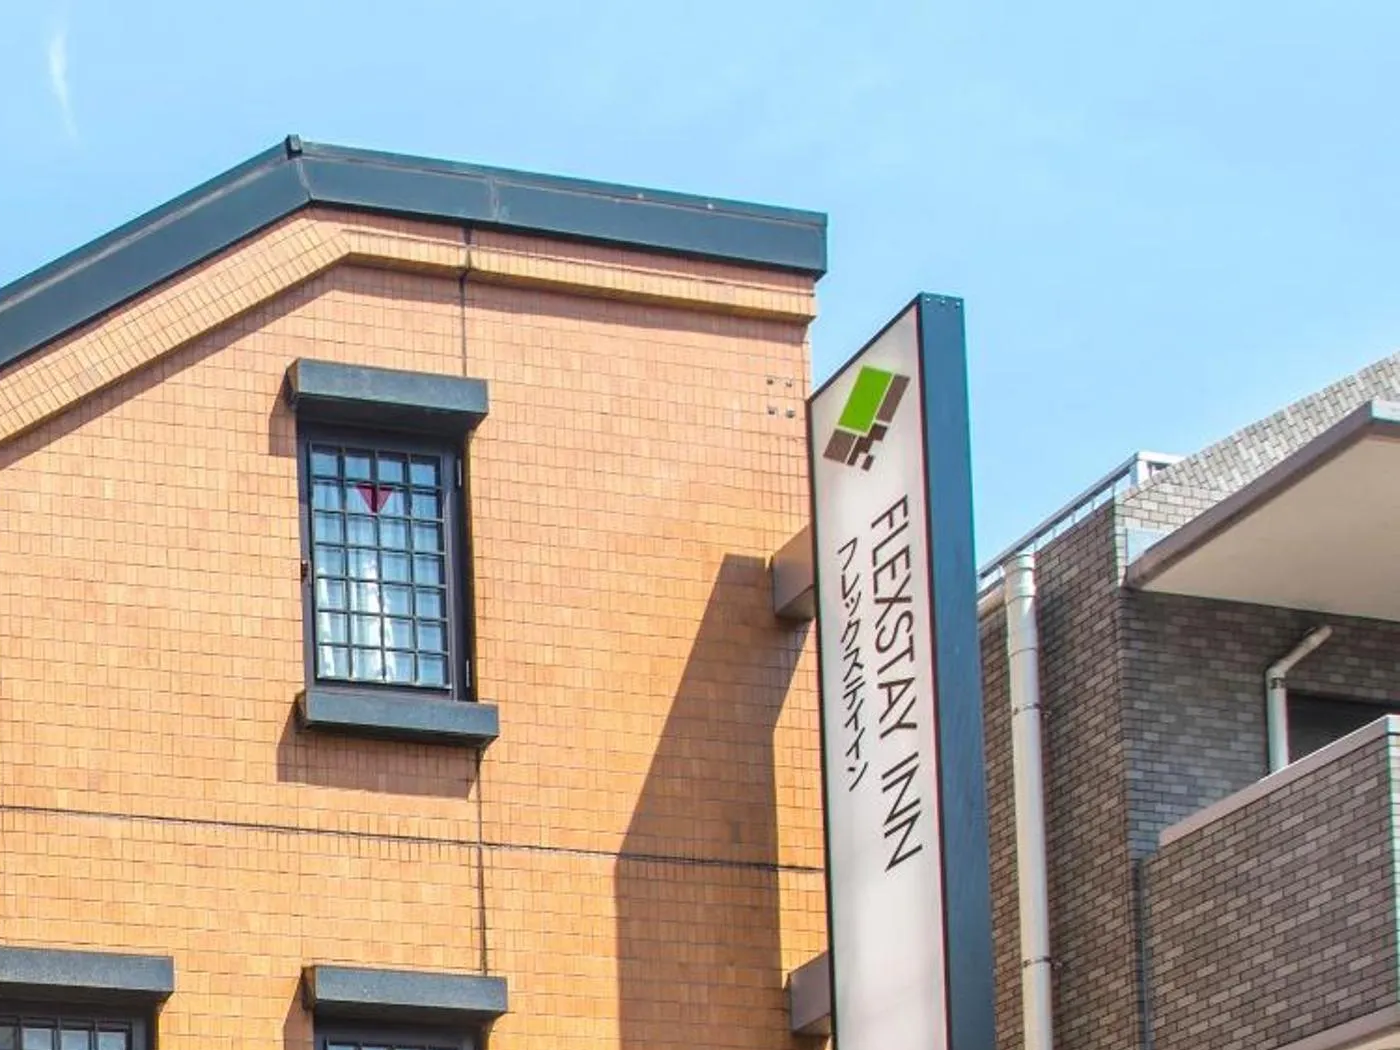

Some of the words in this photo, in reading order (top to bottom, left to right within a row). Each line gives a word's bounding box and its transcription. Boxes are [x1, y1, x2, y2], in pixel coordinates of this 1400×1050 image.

[837, 537, 869, 792] フレックステイイン
[871, 495, 917, 739] FLEXSTAY
[881, 751, 923, 872] INN
